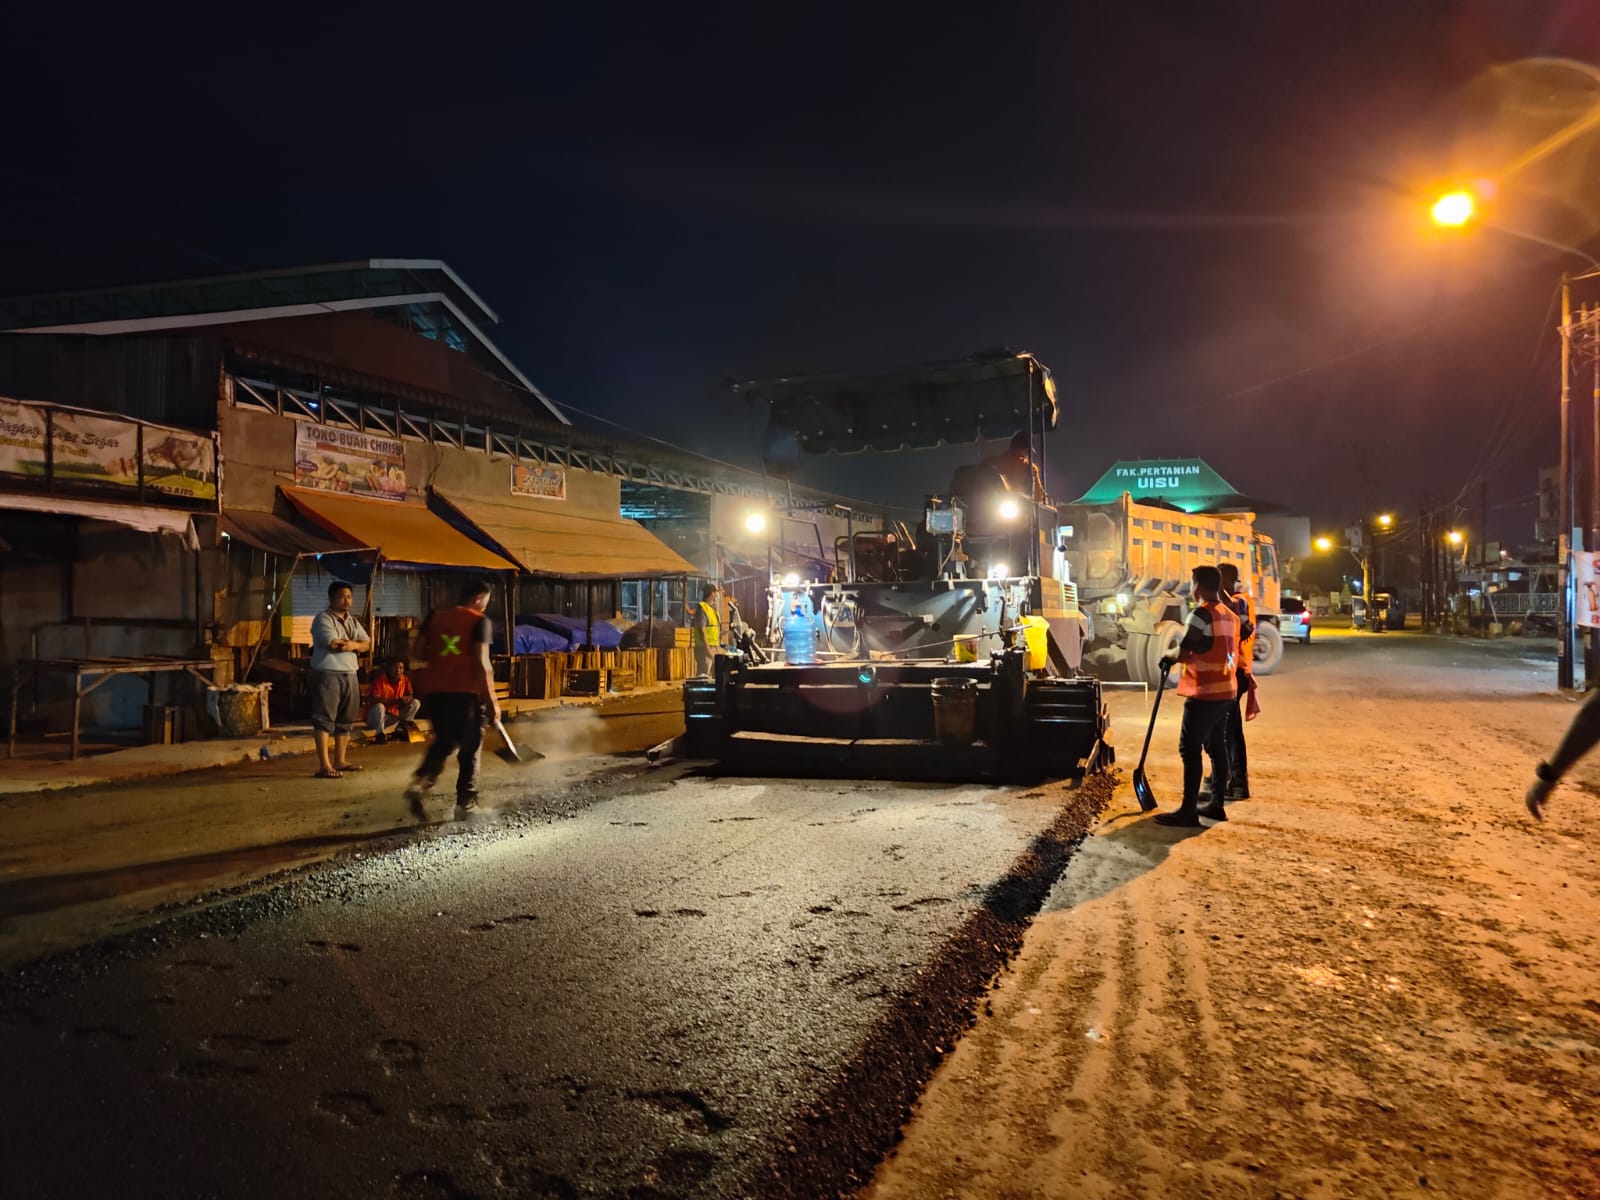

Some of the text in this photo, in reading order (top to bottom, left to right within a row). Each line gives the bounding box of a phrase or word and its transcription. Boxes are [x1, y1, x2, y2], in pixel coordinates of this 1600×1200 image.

[81, 432, 120, 449] Segar
[306, 426, 336, 442] TOKO
[340, 432, 367, 449] BUAH
[1116, 465, 1200, 489] FAK.PERTANIAN UISU
